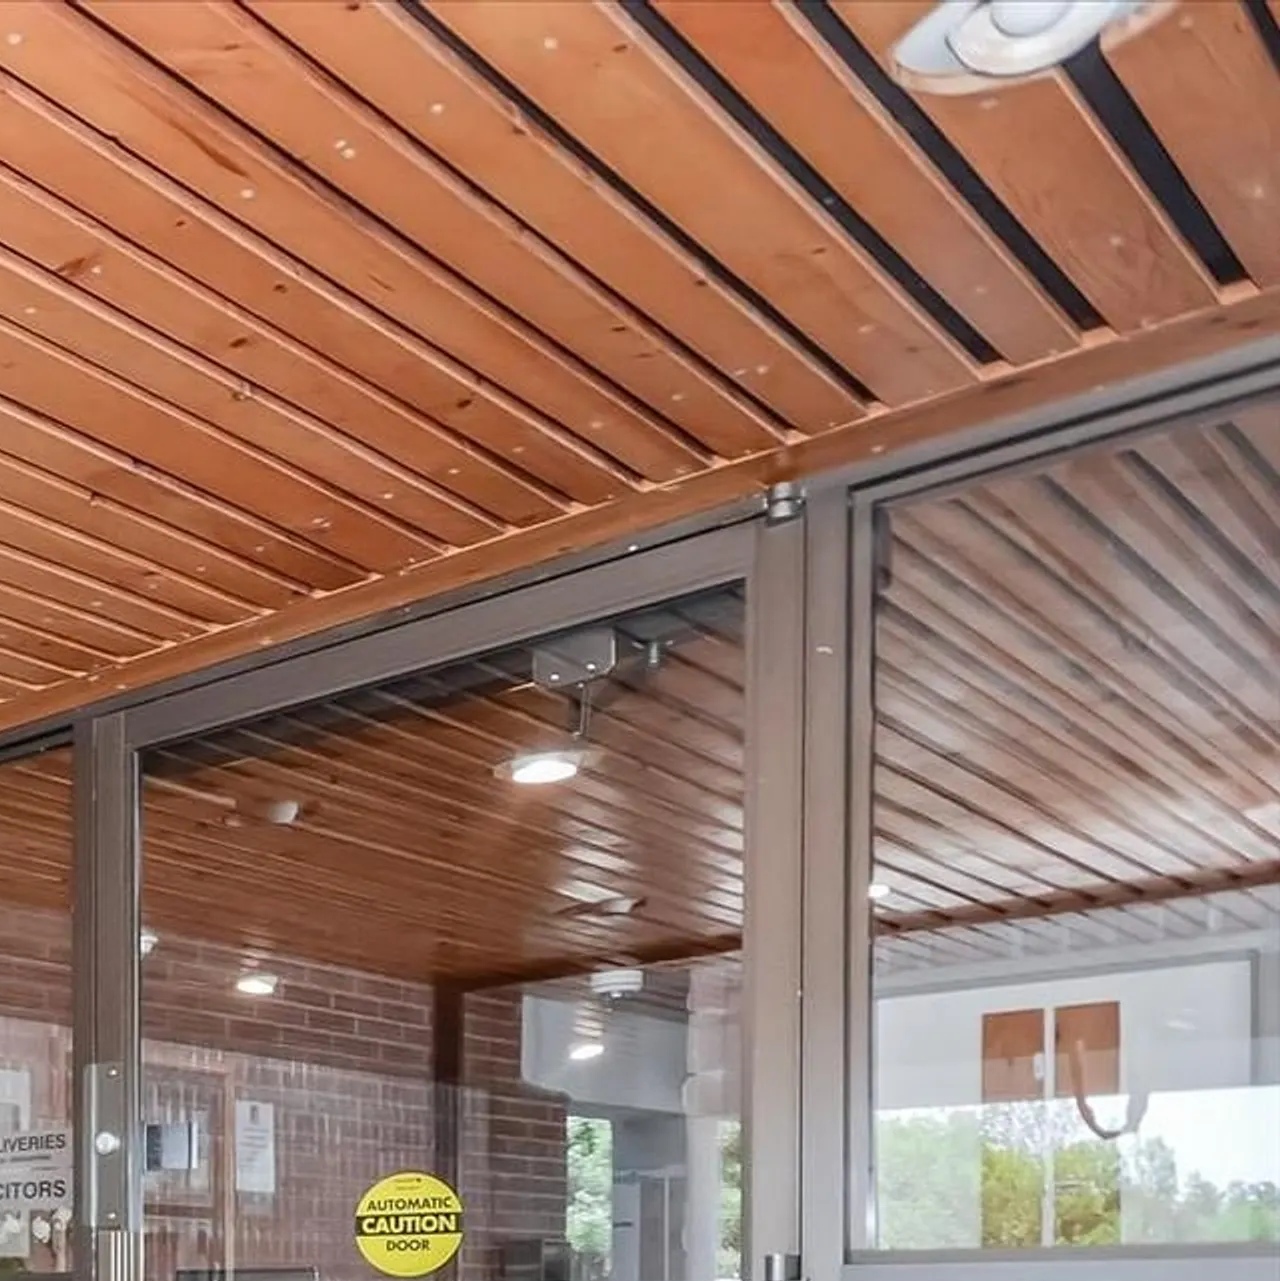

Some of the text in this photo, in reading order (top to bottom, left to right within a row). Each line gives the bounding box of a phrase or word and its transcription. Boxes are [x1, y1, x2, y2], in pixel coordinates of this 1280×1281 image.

[367, 1196, 452, 1212] AUTOMATIC
[362, 1214, 456, 1234] CAUTION
[386, 1239, 430, 1252] DOOR
